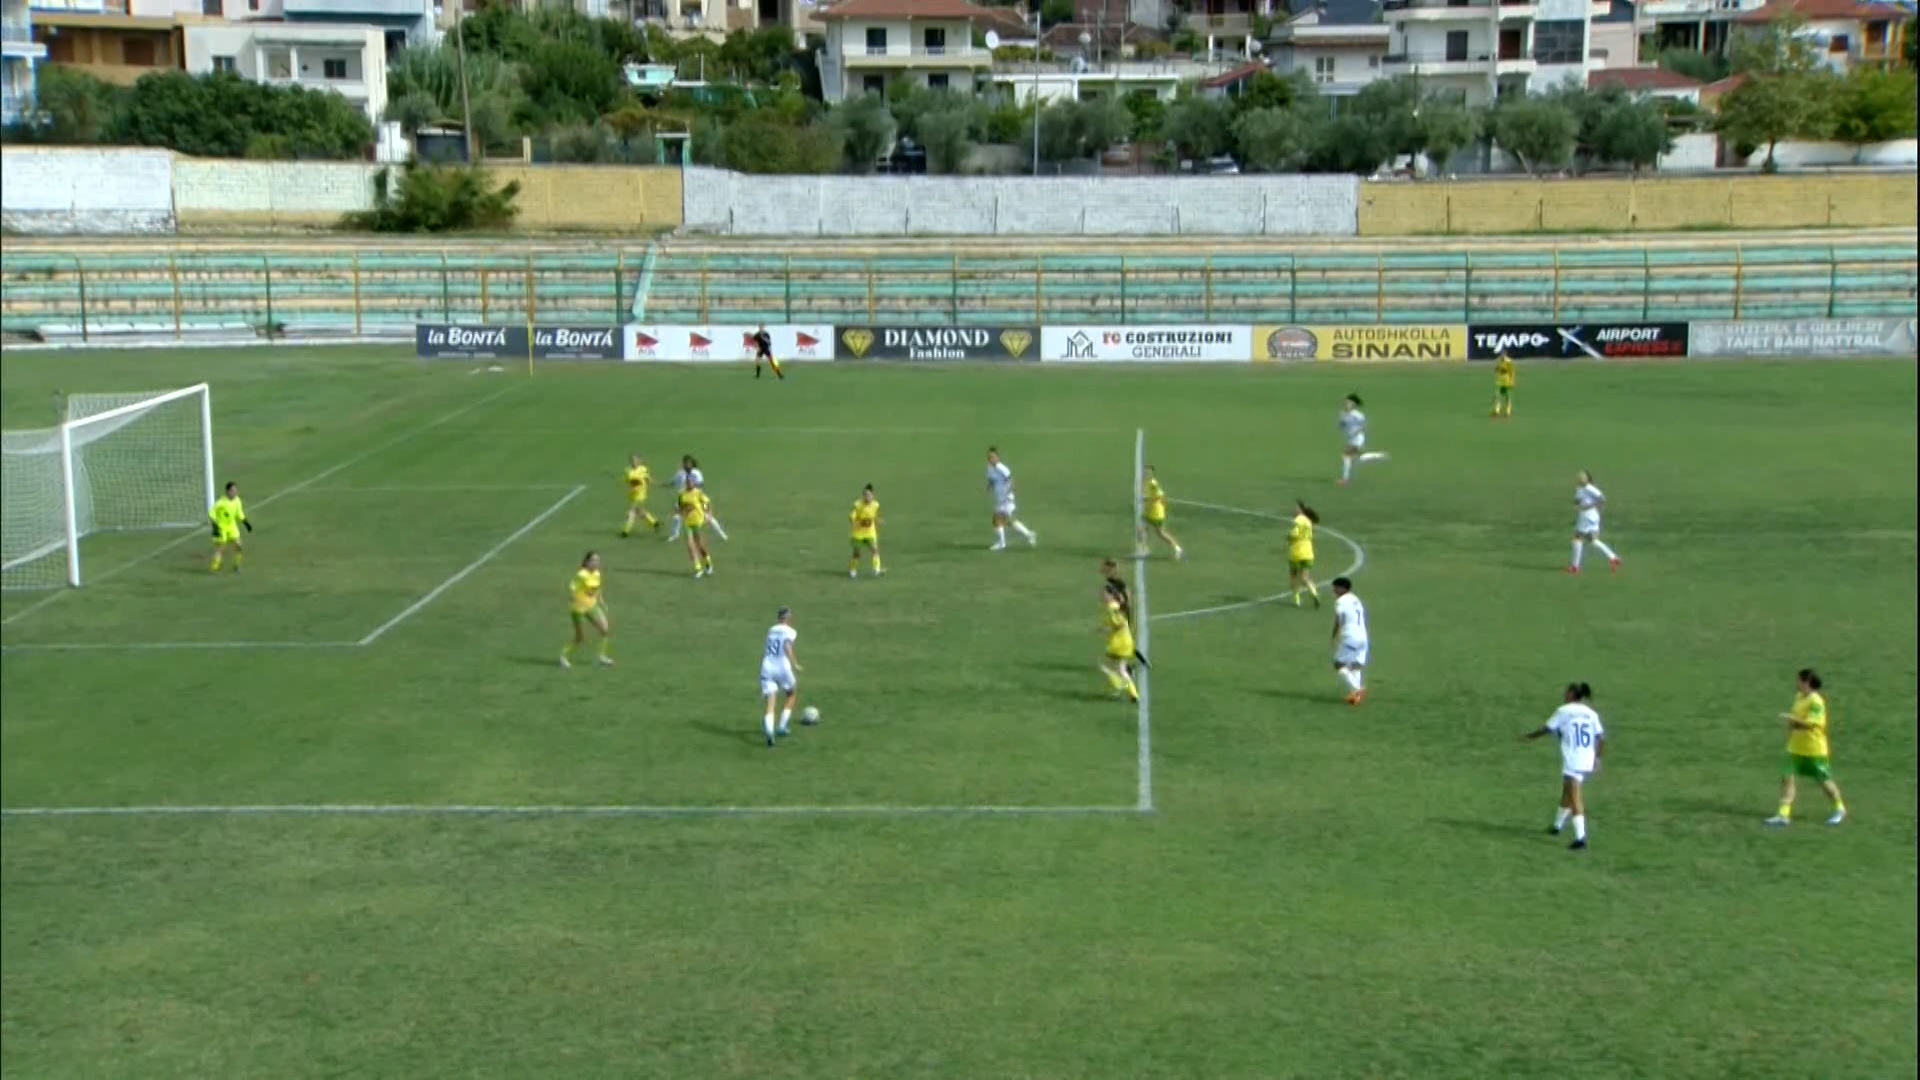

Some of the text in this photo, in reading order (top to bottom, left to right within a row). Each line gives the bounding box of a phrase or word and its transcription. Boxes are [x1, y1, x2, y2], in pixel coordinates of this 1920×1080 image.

[428, 329, 445, 344] la
[535, 330, 552, 346] la
[884, 328, 990, 347] DIAMOND
[1125, 331, 1233, 345] COSTRUZIONI
[1333, 327, 1451, 340] AUTOSHKOLLA
[1596, 327, 1661, 341] AIRPORT
[1474, 333, 1550, 353] TEMPO
[909, 347, 965, 360] Fashion
[1132, 345, 1202, 358] GENERALI
[1332, 343, 1451, 359] SINANI
[1572, 722, 1591, 748] 16
